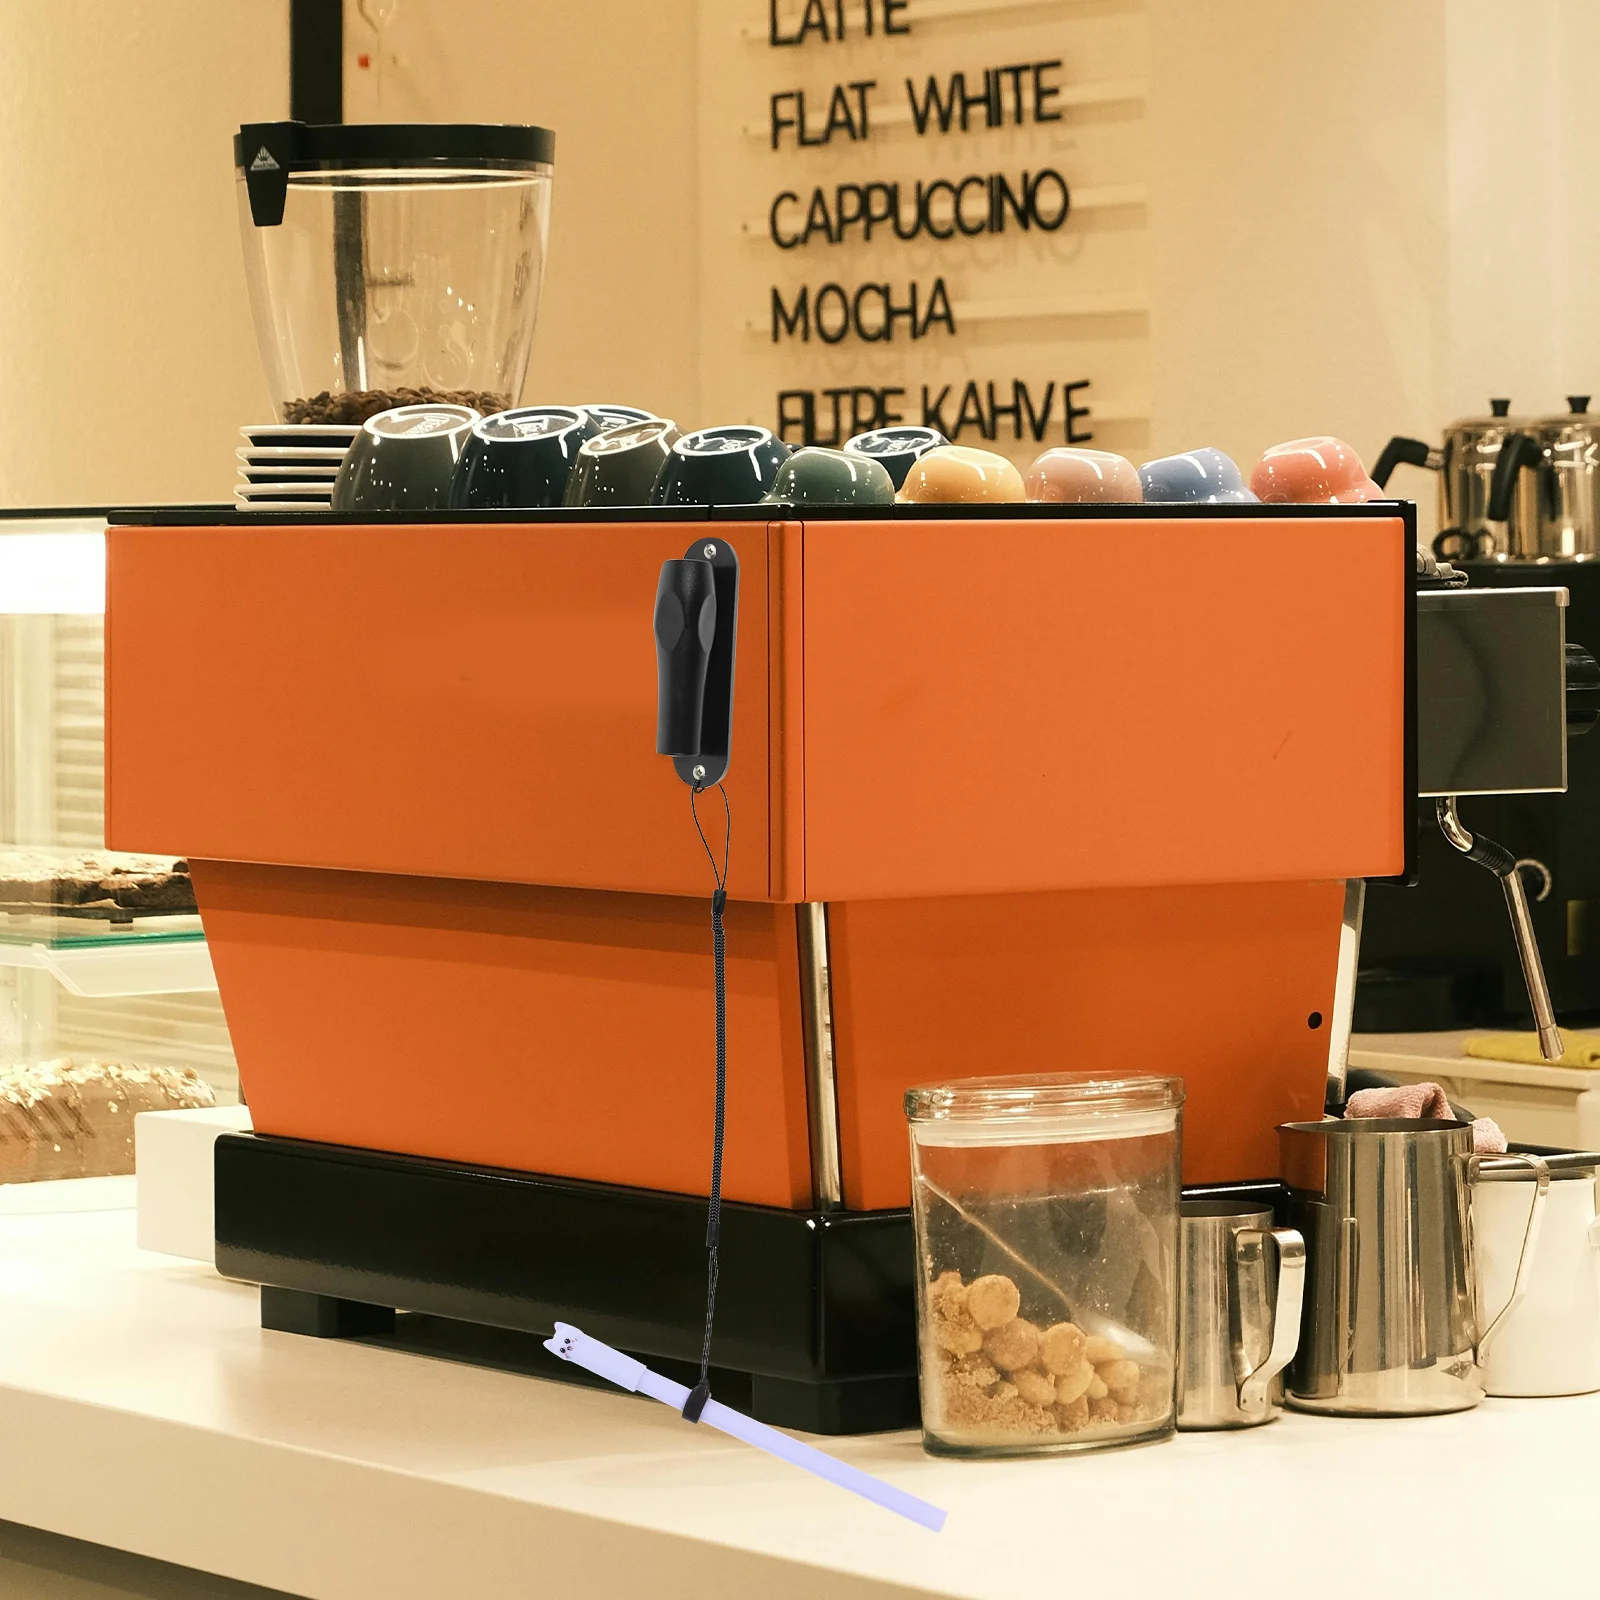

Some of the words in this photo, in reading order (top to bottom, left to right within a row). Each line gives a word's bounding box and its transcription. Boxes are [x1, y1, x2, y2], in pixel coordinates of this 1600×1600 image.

[771, 81, 877, 151] FLAT
[905, 60, 1063, 136] WHITE
[770, 169, 1070, 249] CAPPUCCINO
[771, 278, 956, 345] MOCHA
[921, 379, 1093, 445] KAHVE
